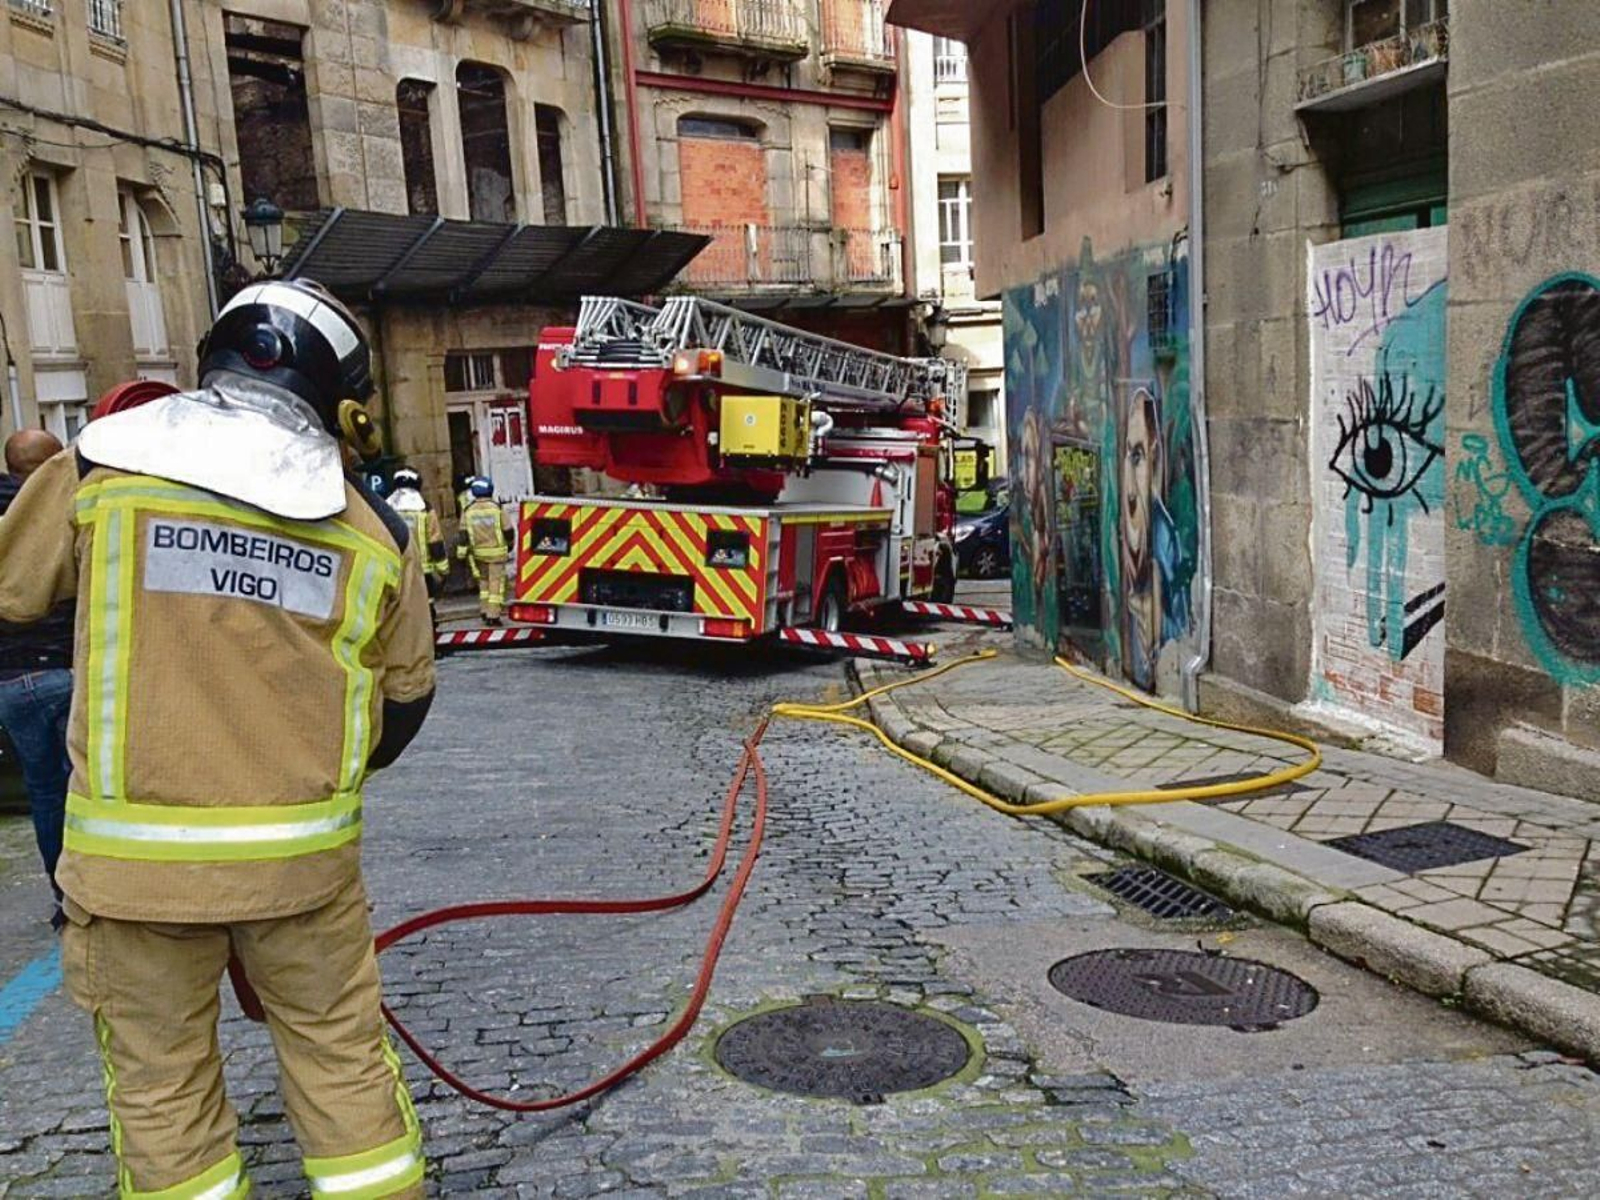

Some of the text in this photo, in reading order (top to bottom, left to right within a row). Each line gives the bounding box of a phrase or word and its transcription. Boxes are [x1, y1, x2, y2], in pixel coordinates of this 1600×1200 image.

[538, 425, 583, 435] MAGIRUS
[153, 524, 333, 578] BOMBEIROS
[210, 568, 278, 600] VIGO
